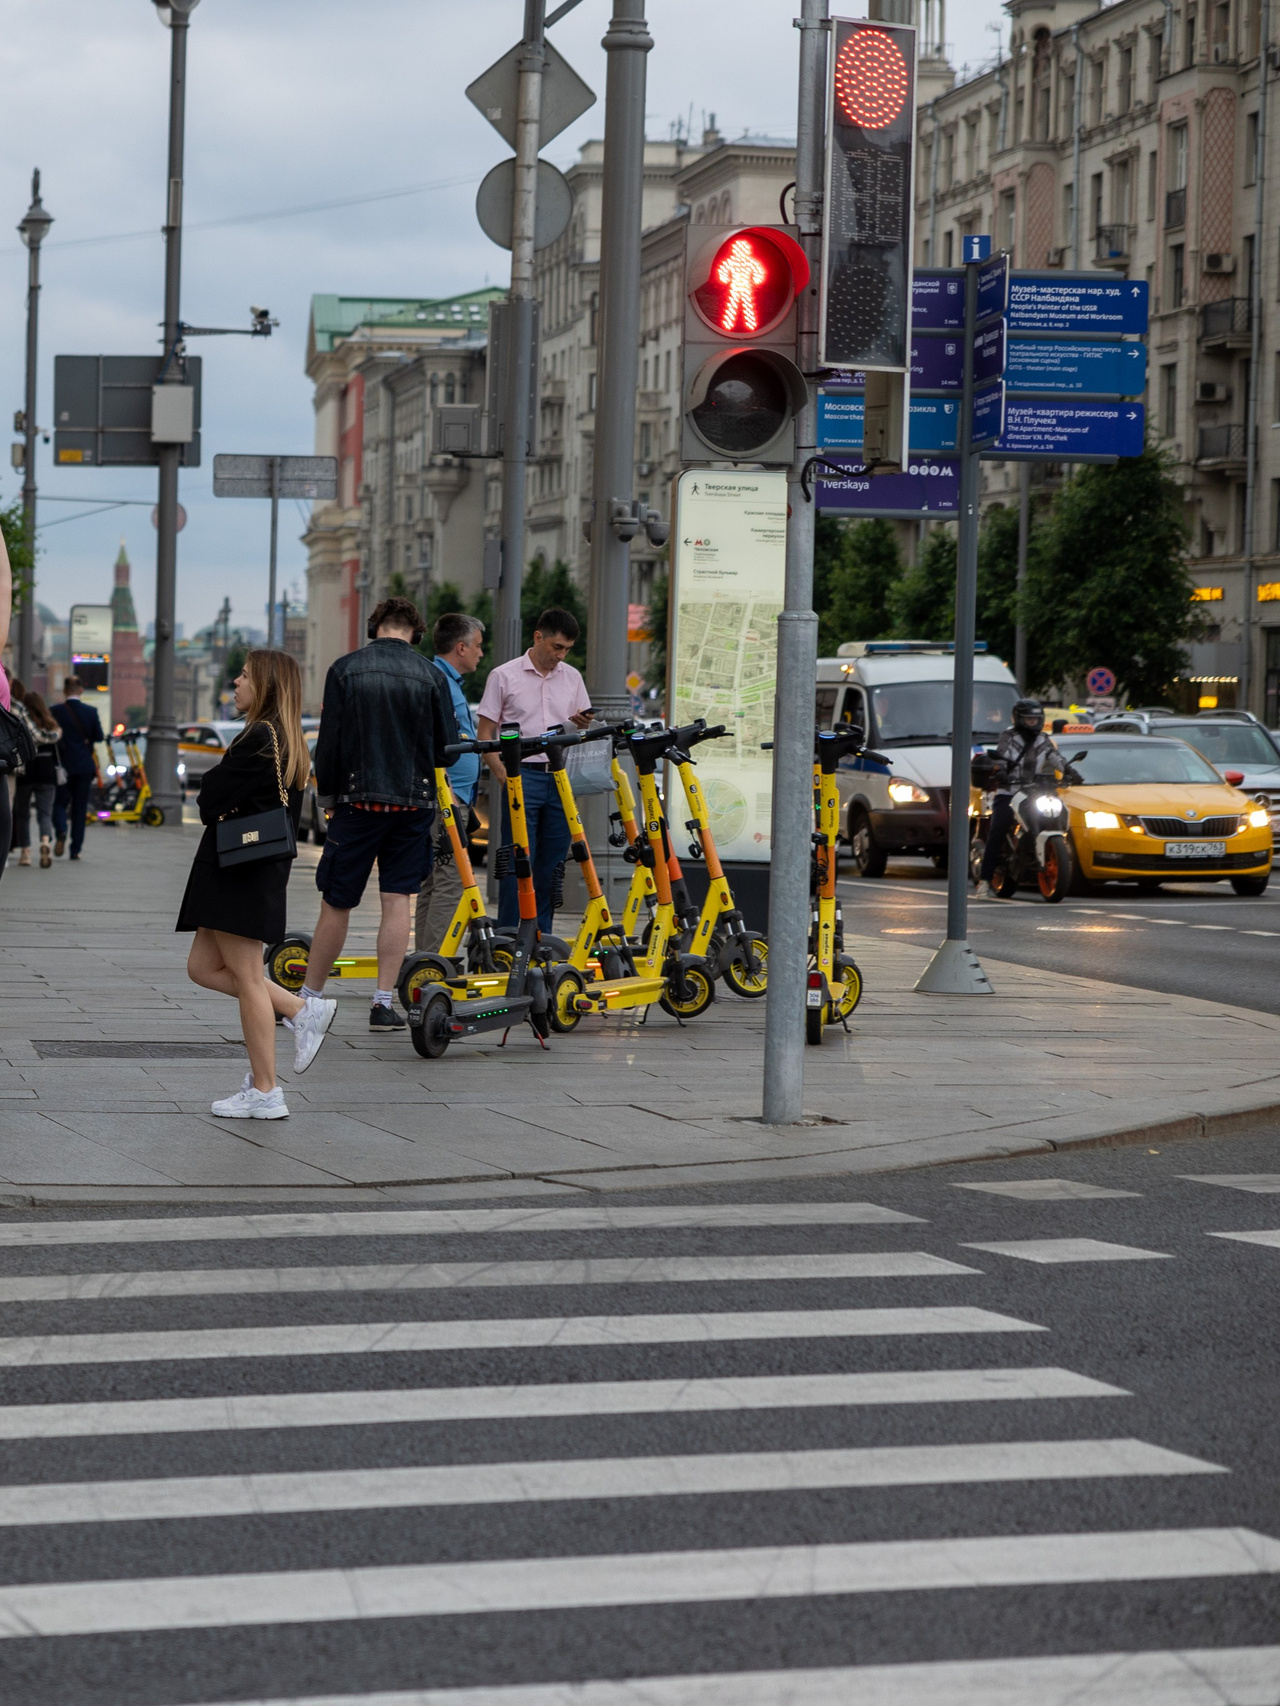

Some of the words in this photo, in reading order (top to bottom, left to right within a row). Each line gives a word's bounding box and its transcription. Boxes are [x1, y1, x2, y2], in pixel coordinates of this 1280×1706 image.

[1011, 285, 1085, 295] Музей-мастерская
[1087, 288, 1104, 296] нар.
[1105, 288, 1122, 296] худ.
[1031, 294, 1079, 303] Налбандяна
[1011, 303, 1037, 311] People's
[1010, 312, 1048, 320] Nalbandyan
[825, 403, 865, 411] Московск
[1008, 408, 1074, 418] Музей-квартира
[1075, 411, 1119, 419] режиссера
[1008, 416, 1022, 424] В.Н.
[1024, 417, 1057, 425] Плучека
[1044, 434, 1068, 442] Pluchek
[823, 464, 866, 476] Тверск
[823, 480, 870, 492] Tverskaya
[690, 784, 697, 793] Go
[443, 808, 450, 818] Go
[647, 797, 656, 820] Яндекс
[650, 821, 659, 831] Go
